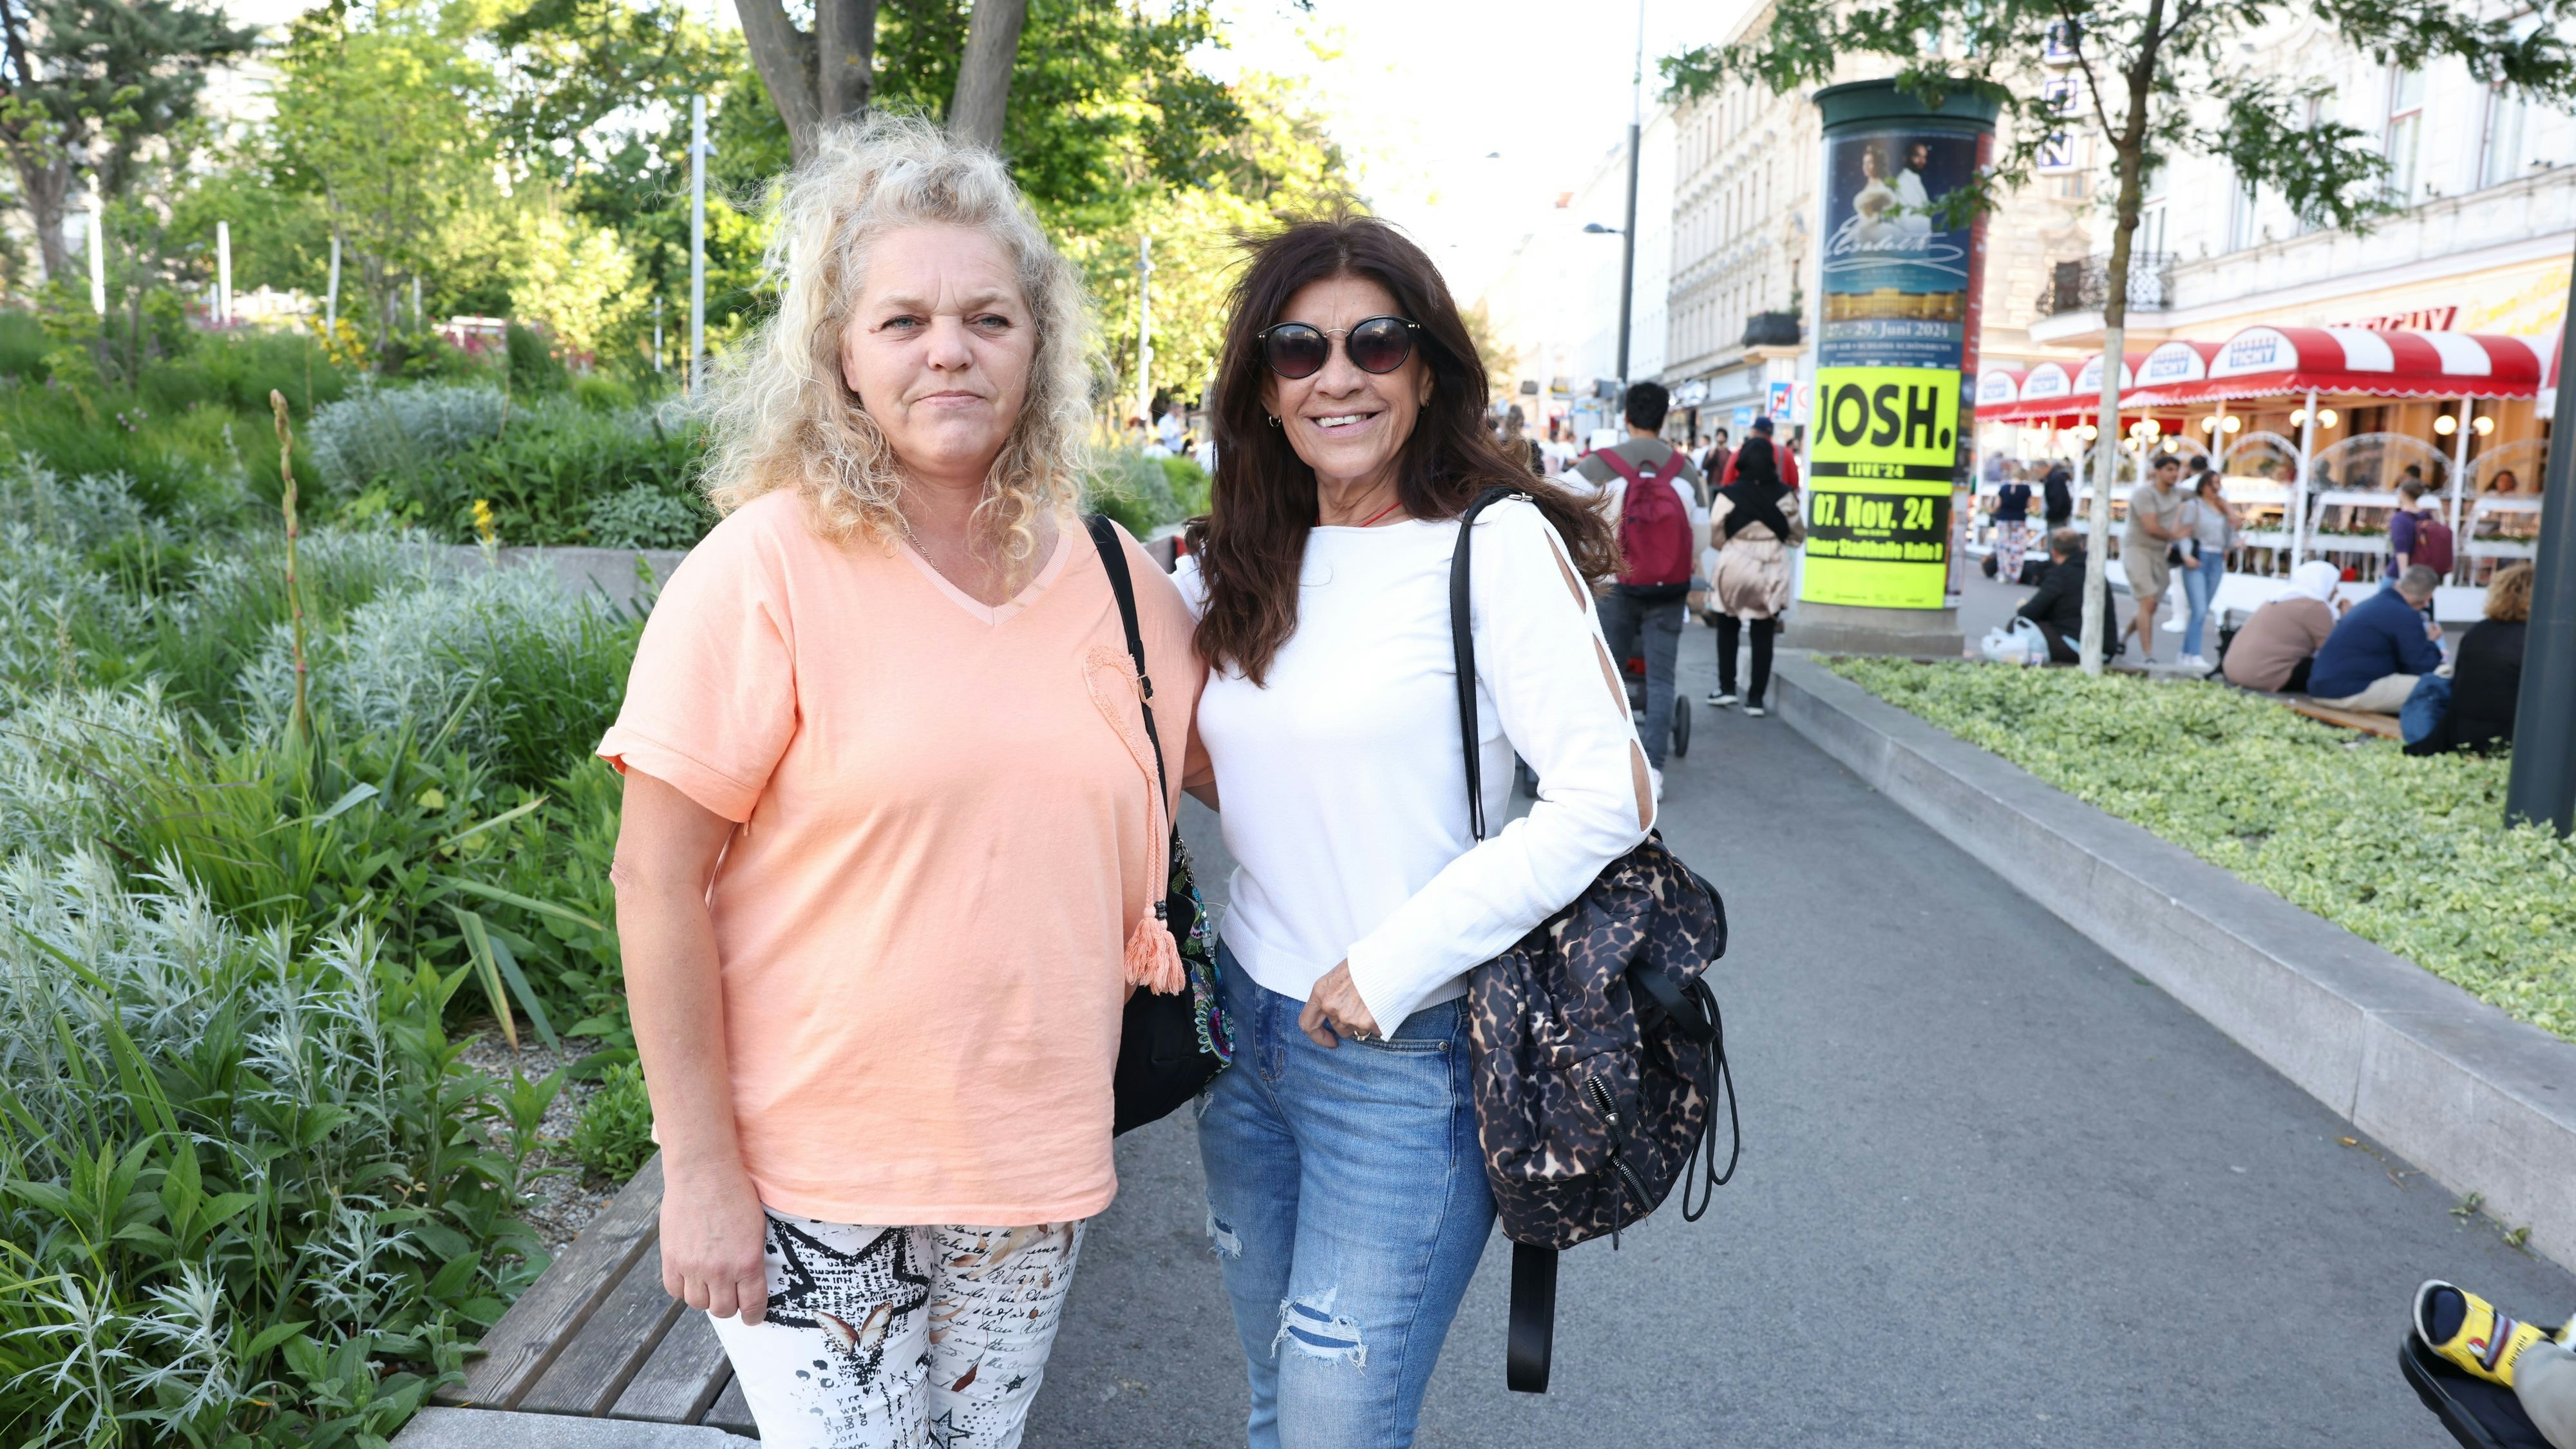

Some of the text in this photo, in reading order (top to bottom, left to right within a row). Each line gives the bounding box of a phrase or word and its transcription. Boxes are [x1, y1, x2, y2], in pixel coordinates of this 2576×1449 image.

[1855, 322, 1876, 337] 29.
[1880, 321, 1911, 338] Juni
[1915, 323, 1949, 338] 2024
[1815, 383, 1951, 450] JOSH.
[1813, 493, 1933, 530] 07. Nov. 24
